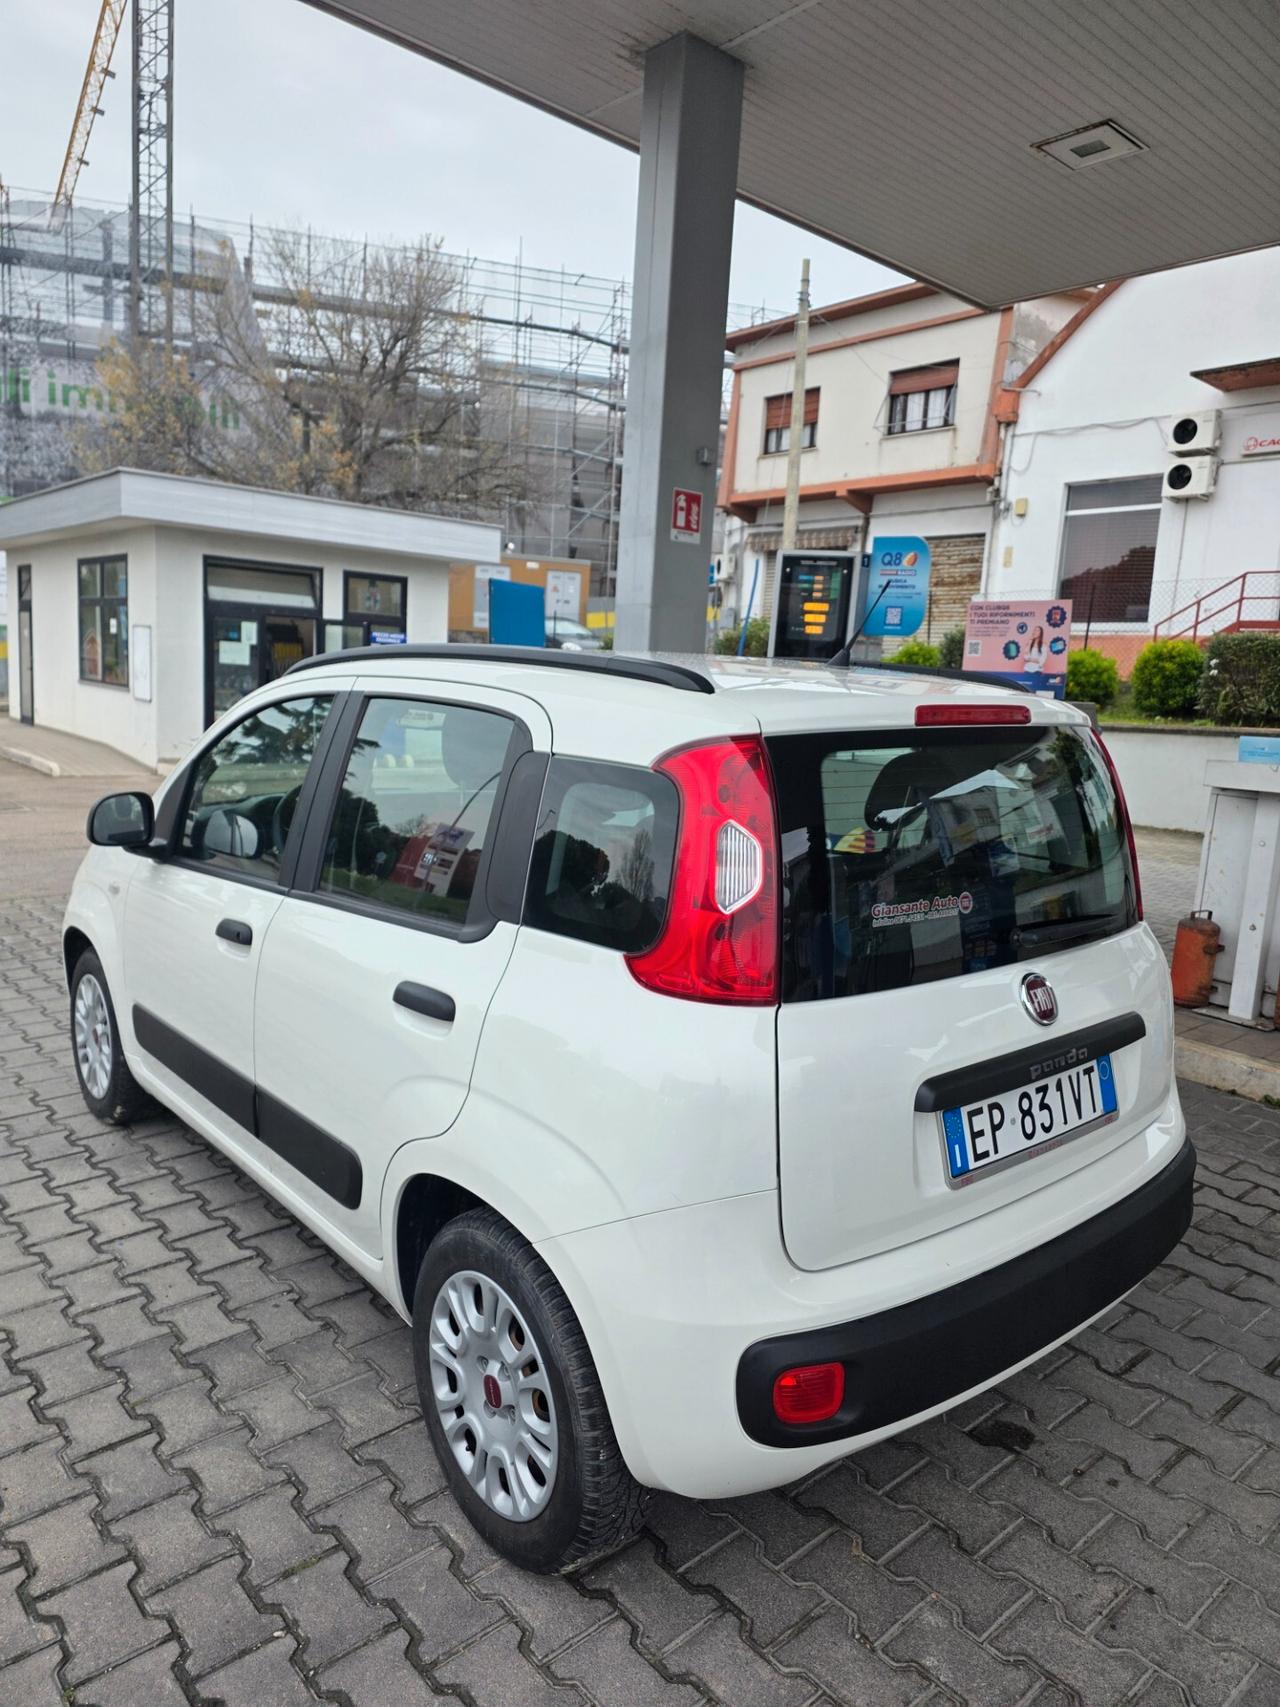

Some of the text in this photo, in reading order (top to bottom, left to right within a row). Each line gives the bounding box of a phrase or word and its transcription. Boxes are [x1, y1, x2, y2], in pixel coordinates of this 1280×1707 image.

[881, 551, 903, 567] Q8
[872, 899, 930, 918] Giansante
[931, 895, 959, 911] Auto
[1029, 985, 1053, 1013] FIAT
[1029, 1047, 1088, 1080] panda
[967, 1065, 1098, 1163] EP 831VT
